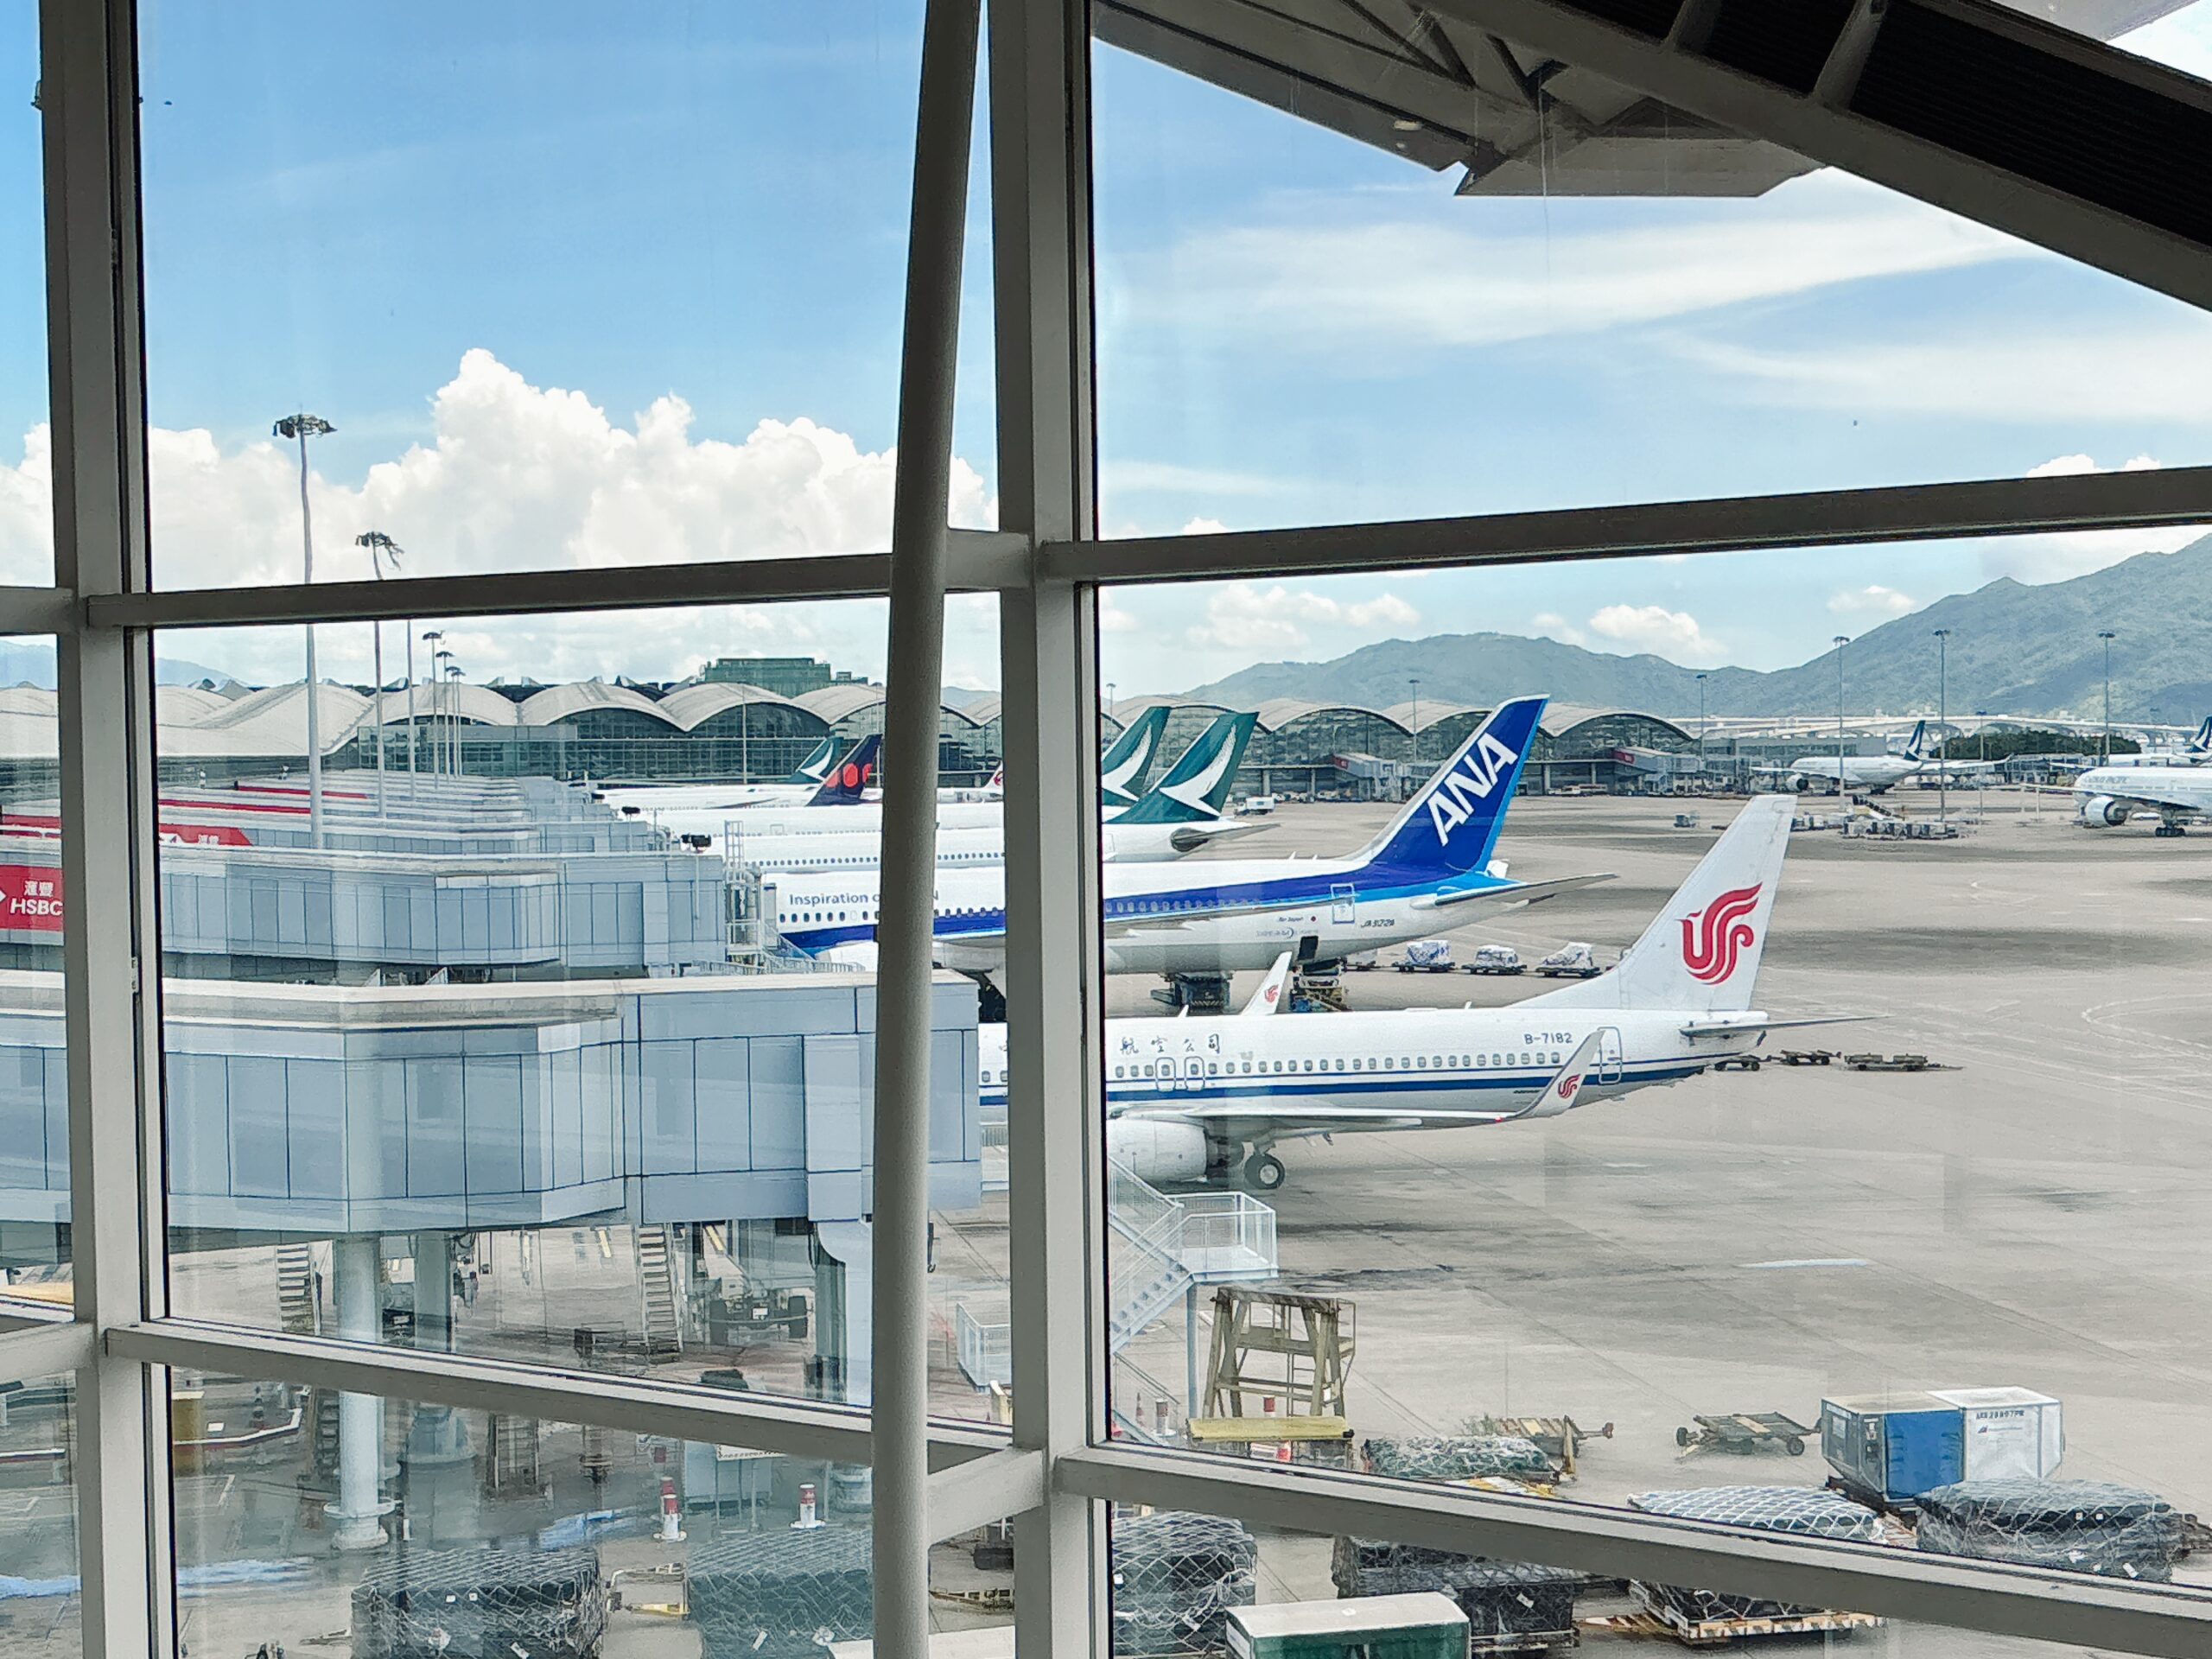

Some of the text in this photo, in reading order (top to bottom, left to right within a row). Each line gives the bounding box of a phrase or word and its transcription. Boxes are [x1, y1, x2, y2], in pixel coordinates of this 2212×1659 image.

[1427, 732, 1518, 847] ANA
[10, 898, 63, 916] HSBC
[790, 893, 868, 907] Inspiration
[1120, 1033, 1219, 1054] 航空公司
[1524, 1033, 1573, 1044] B-7182
